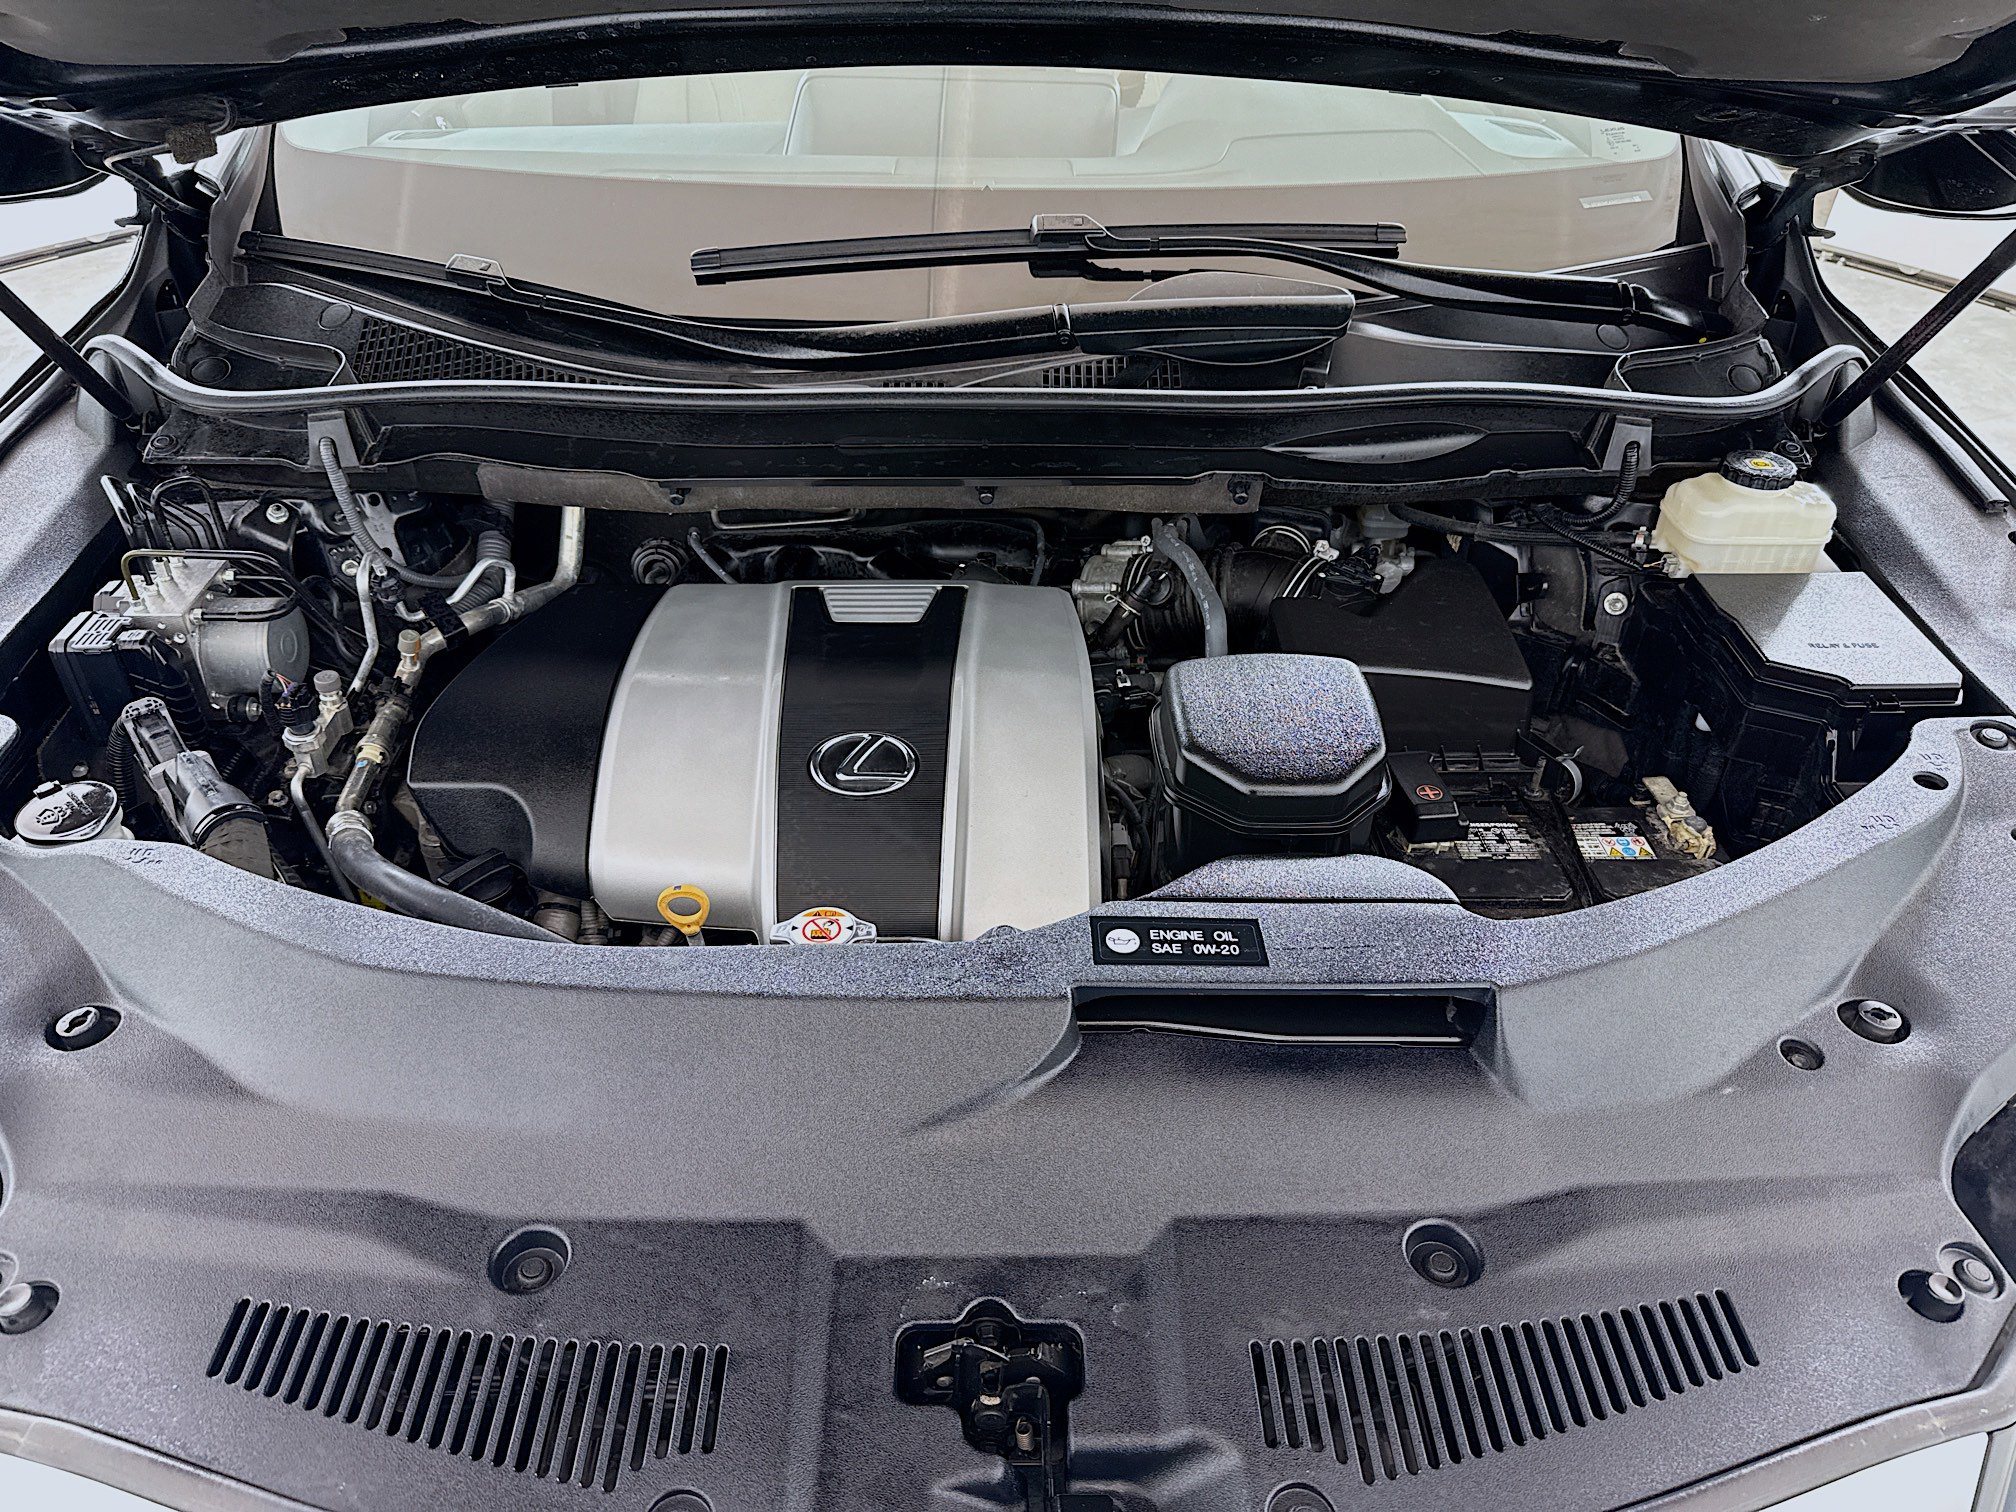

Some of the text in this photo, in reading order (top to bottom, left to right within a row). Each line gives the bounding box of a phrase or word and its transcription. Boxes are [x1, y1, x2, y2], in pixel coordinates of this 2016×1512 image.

[1149, 929, 1238, 942] ENGINE OIL
[1151, 943, 1239, 955] SAE 0W-20
